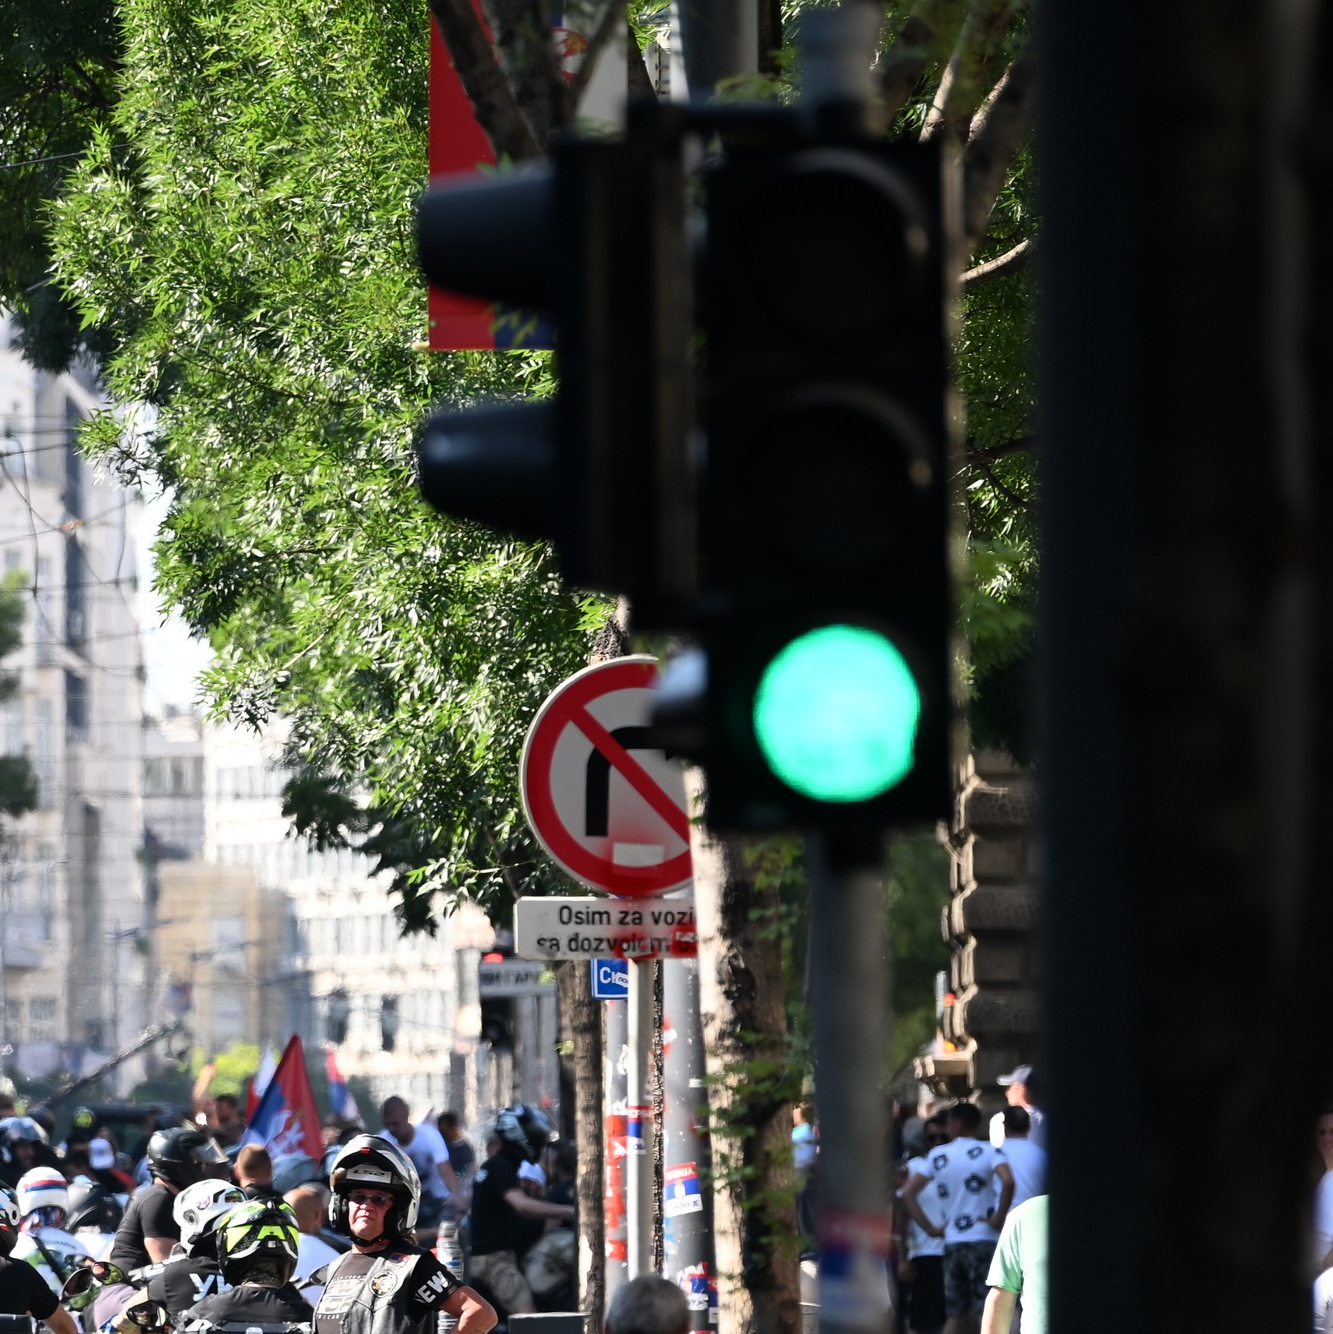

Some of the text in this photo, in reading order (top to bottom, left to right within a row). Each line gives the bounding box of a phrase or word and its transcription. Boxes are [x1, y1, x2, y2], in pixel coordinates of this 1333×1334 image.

[559, 905, 696, 926] Osim za vozi
[536, 936, 561, 953] sa
